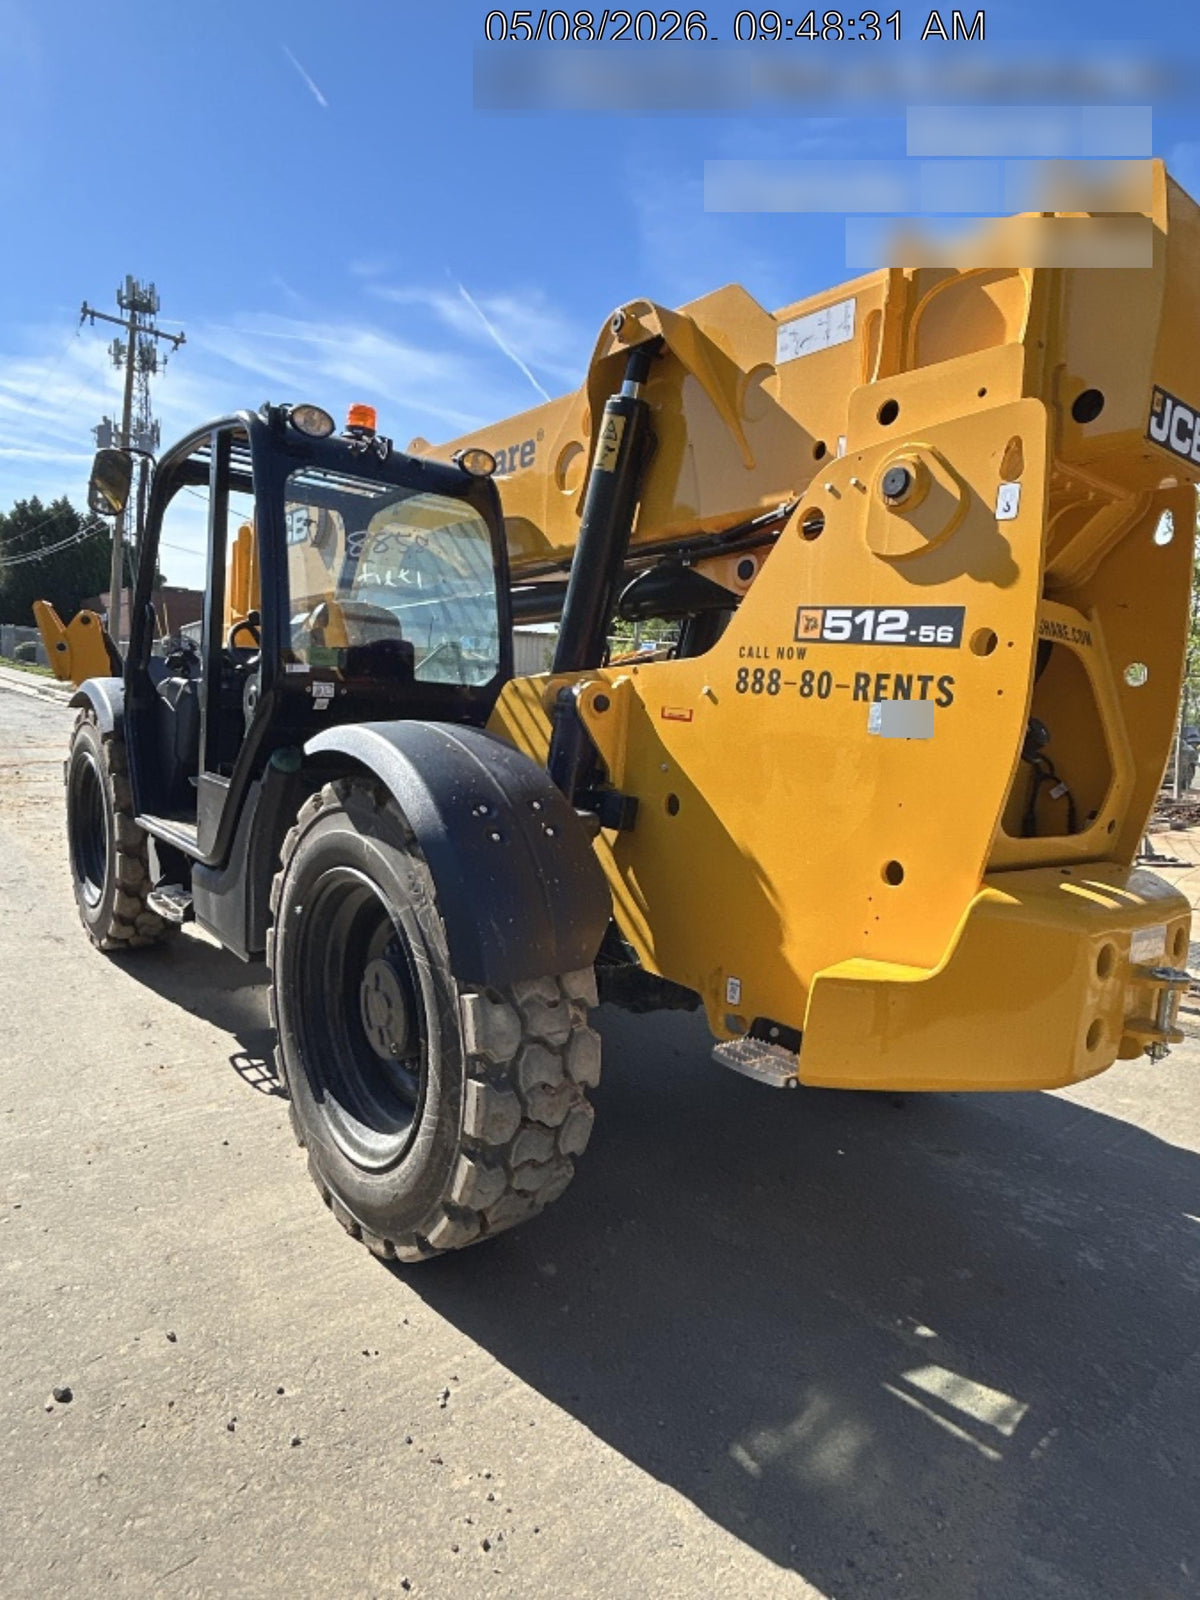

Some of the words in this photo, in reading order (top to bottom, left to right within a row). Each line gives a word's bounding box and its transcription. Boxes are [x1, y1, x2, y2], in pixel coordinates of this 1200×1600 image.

[822, 608, 955, 643] 512-56
[738, 646, 770, 659] CALL
[776, 646, 808, 661] NOW
[735, 667, 956, 708] 888-80-RENTS
